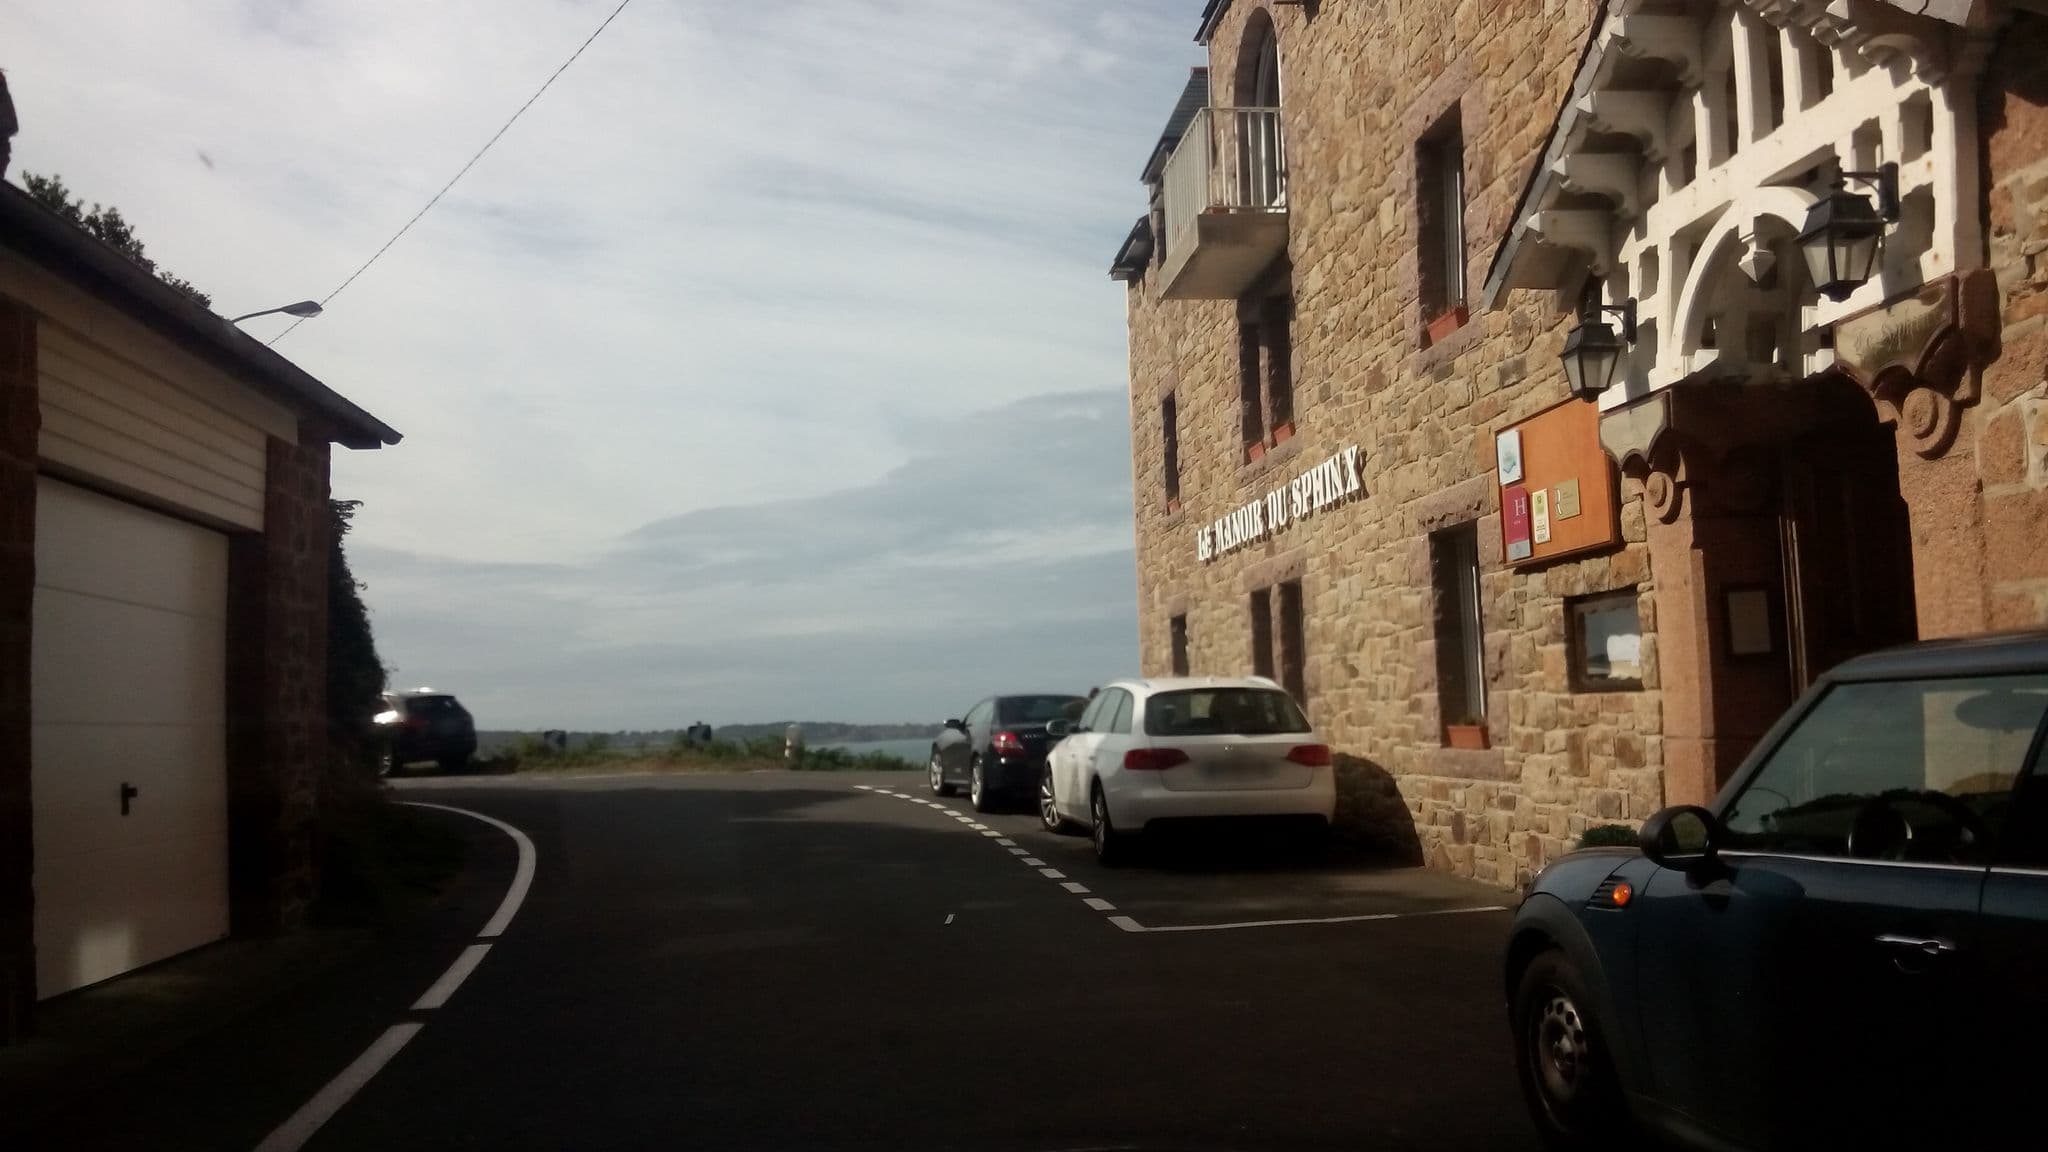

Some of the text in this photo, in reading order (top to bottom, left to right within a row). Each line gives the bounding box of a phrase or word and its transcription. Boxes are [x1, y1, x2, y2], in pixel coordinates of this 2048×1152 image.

[1198, 445, 1359, 560] LE MANOIR DU SPHINX
[1515, 497, 1526, 516] H
